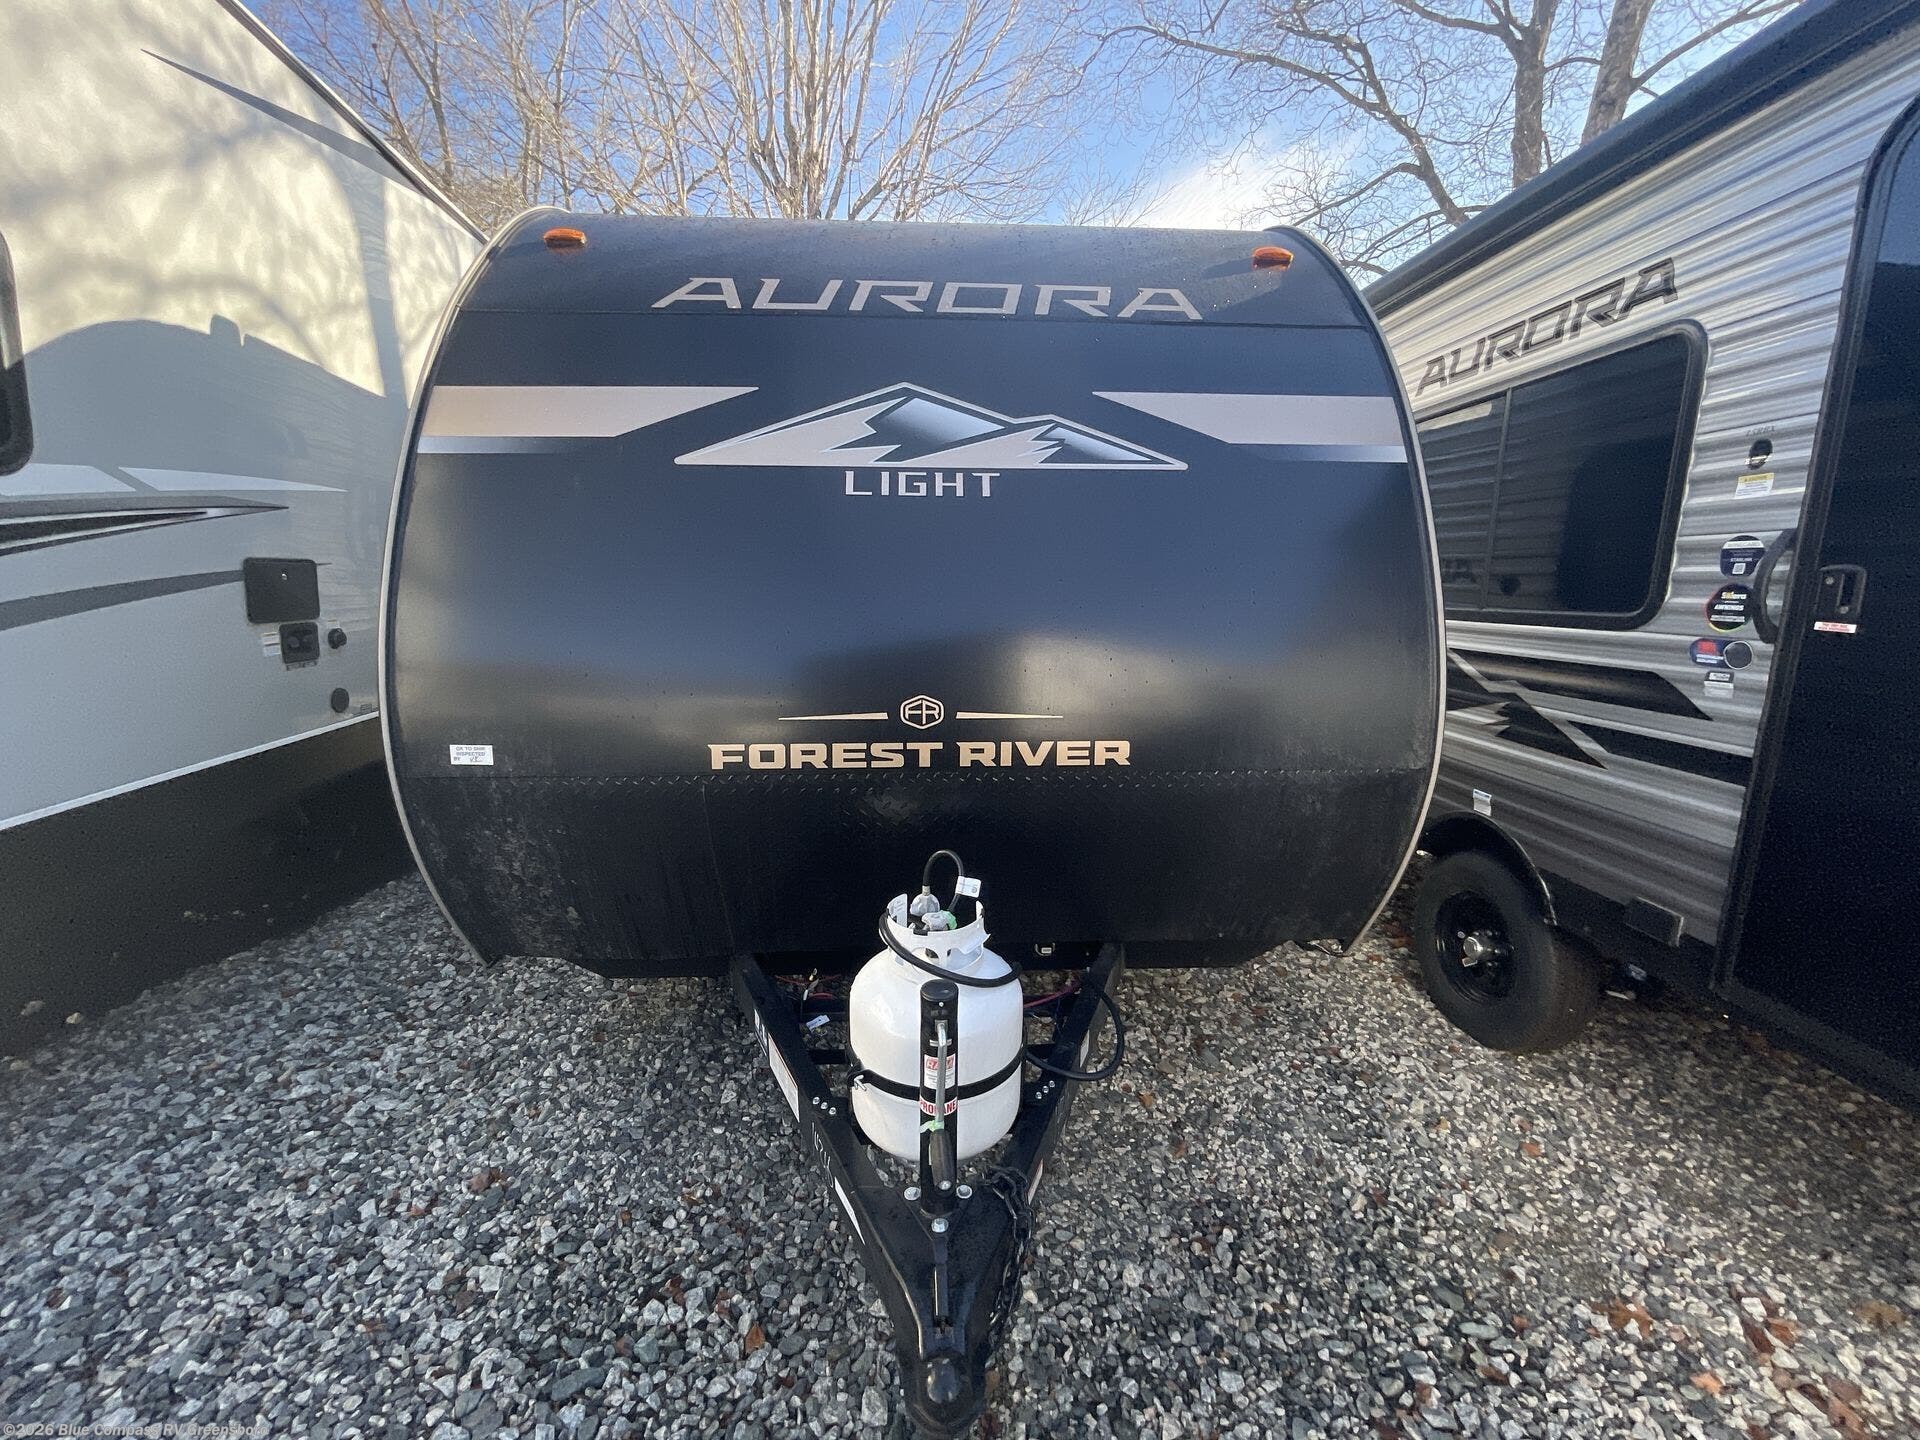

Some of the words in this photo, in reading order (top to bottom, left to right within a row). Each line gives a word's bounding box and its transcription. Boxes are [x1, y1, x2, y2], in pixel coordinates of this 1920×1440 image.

[651, 277, 1203, 320] AURORA
[1415, 257, 1678, 397] AURORA
[845, 471, 1000, 497] LIGHT
[707, 742, 943, 769] FOREST
[956, 740, 1131, 767] RIVER
